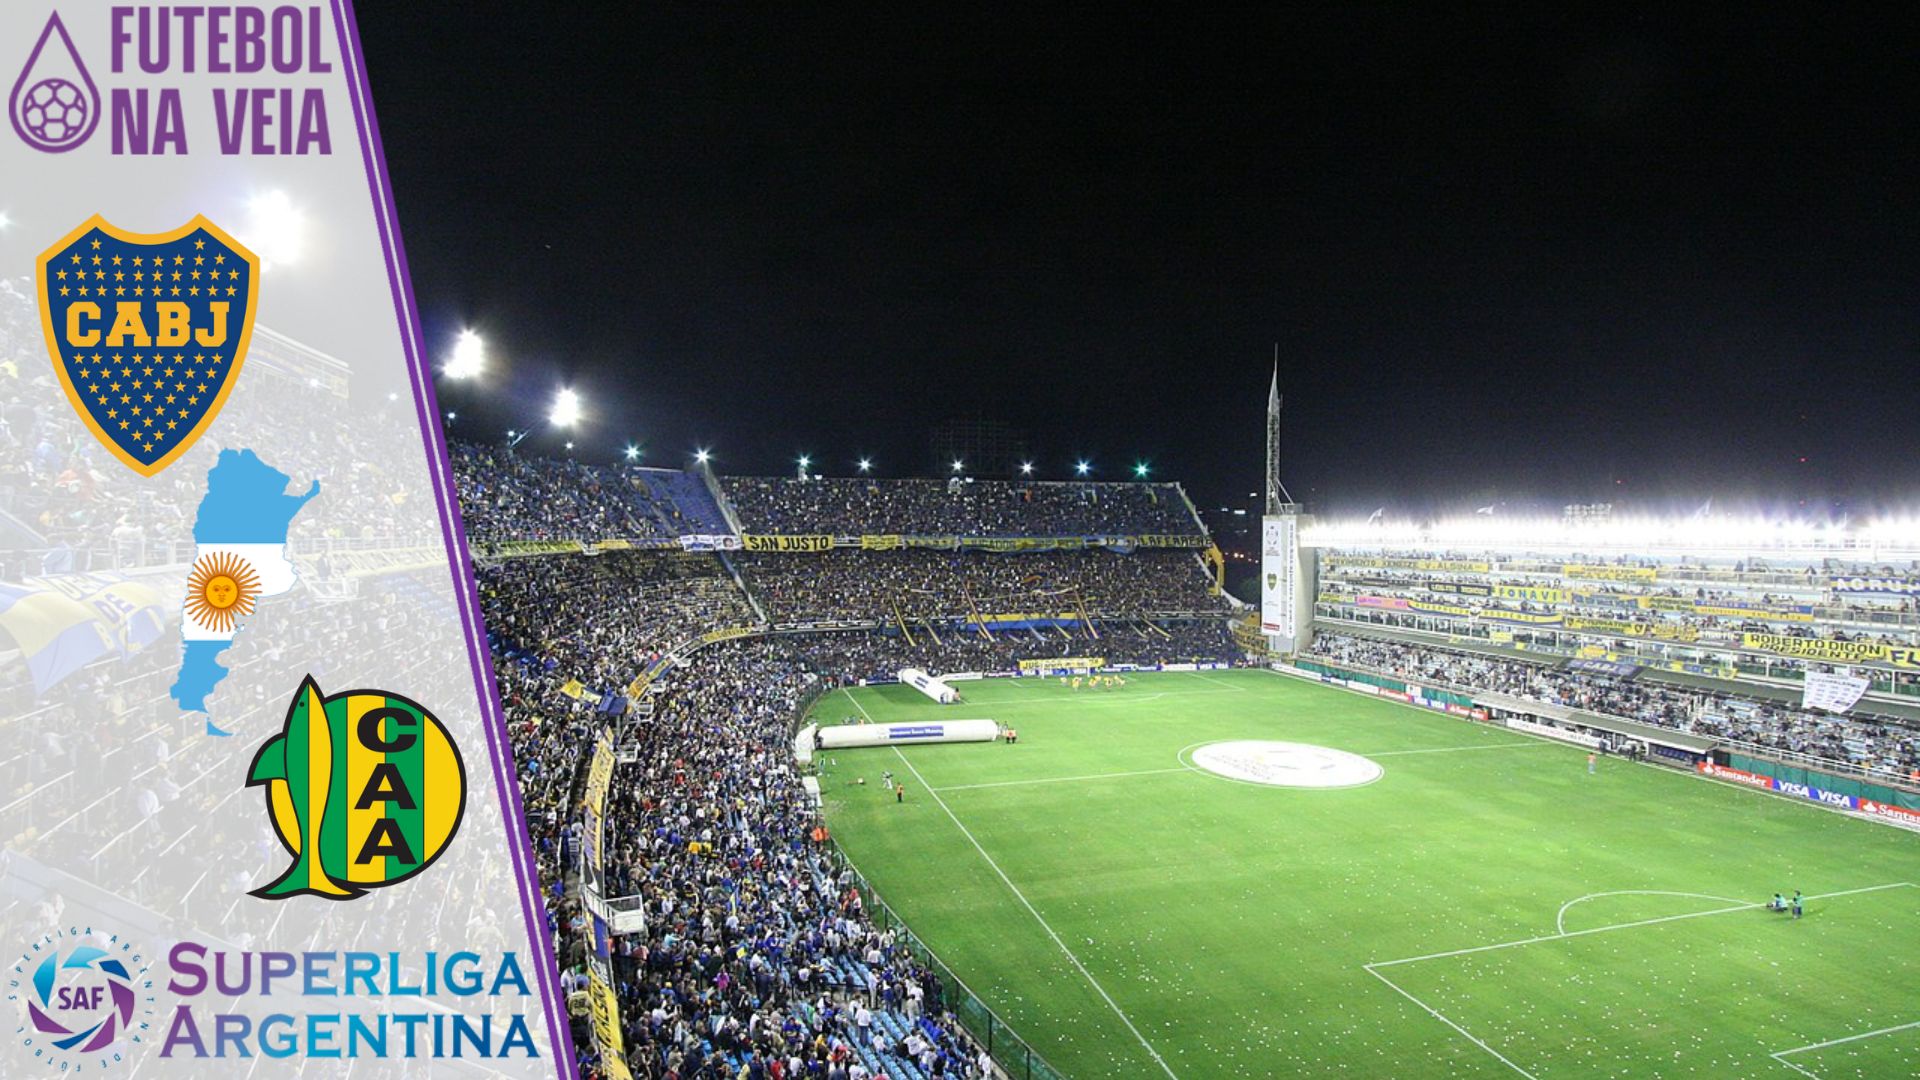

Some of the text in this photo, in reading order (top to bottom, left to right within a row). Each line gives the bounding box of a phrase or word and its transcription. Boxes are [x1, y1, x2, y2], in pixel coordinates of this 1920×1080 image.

[749, 537, 779, 550] SAN
[783, 537, 829, 550] JUSTO
[1499, 588, 1558, 602] FONAVI
[1750, 633, 1881, 655] ROBERTO DIGON
[1758, 642, 1865, 661] PRESIDENTE
[1714, 766, 1767, 787] Santander
[1778, 780, 1810, 797] VISA
[1817, 790, 1851, 808] VISA
